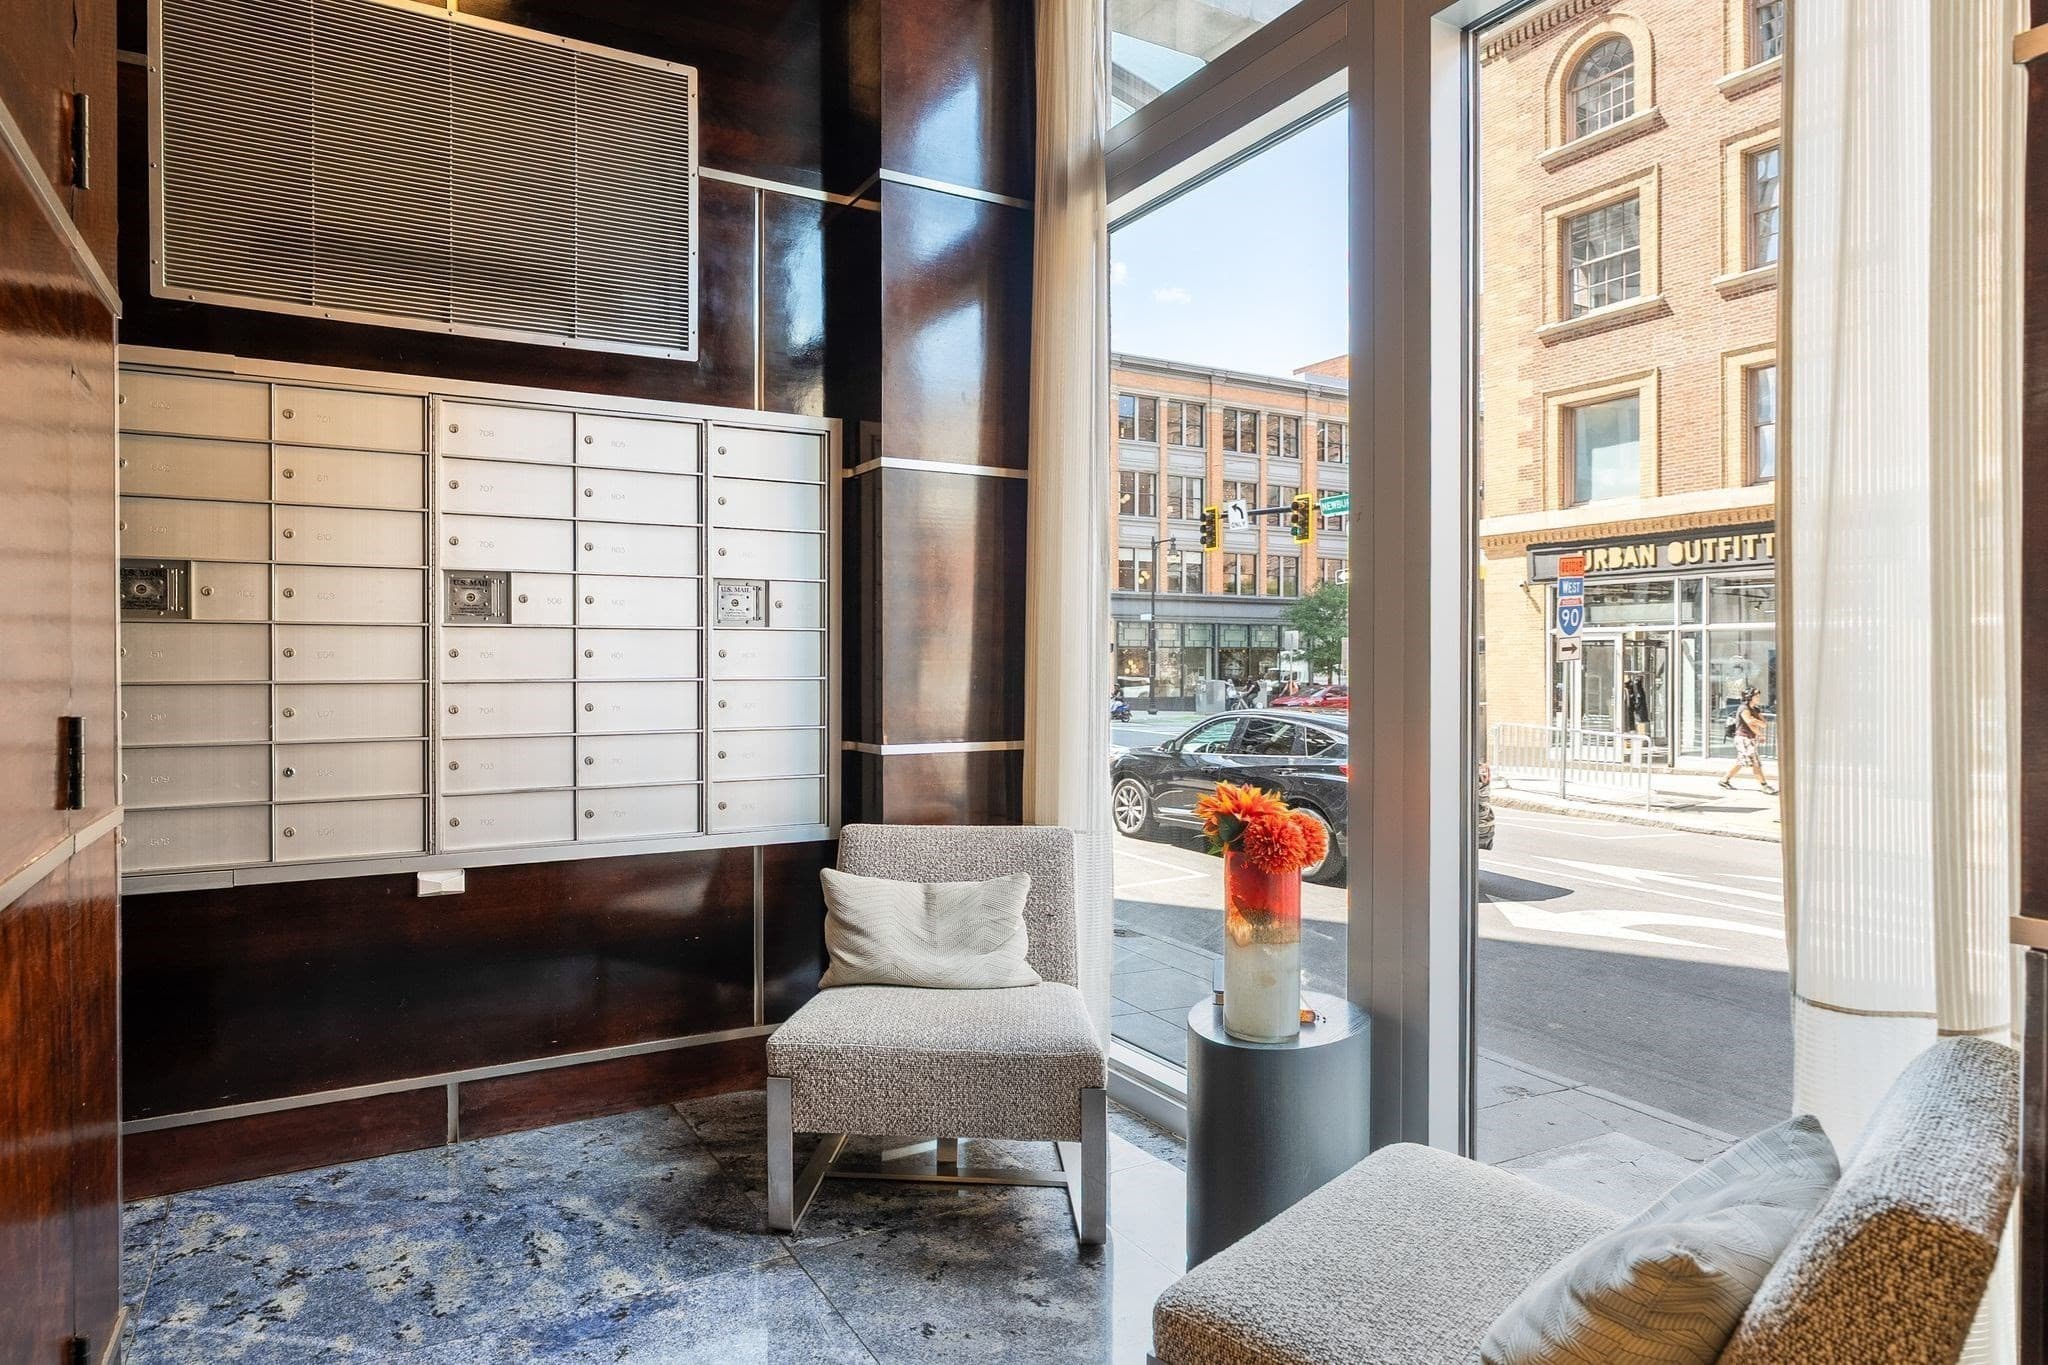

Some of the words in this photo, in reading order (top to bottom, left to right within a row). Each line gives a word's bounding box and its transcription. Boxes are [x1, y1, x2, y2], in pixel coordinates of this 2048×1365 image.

[479, 429, 494, 438] 708
[480, 484, 494, 493] 707
[1231, 520, 1246, 528] ONLY
[1562, 581, 1581, 594] WEST
[1561, 608, 1579, 627] 90
